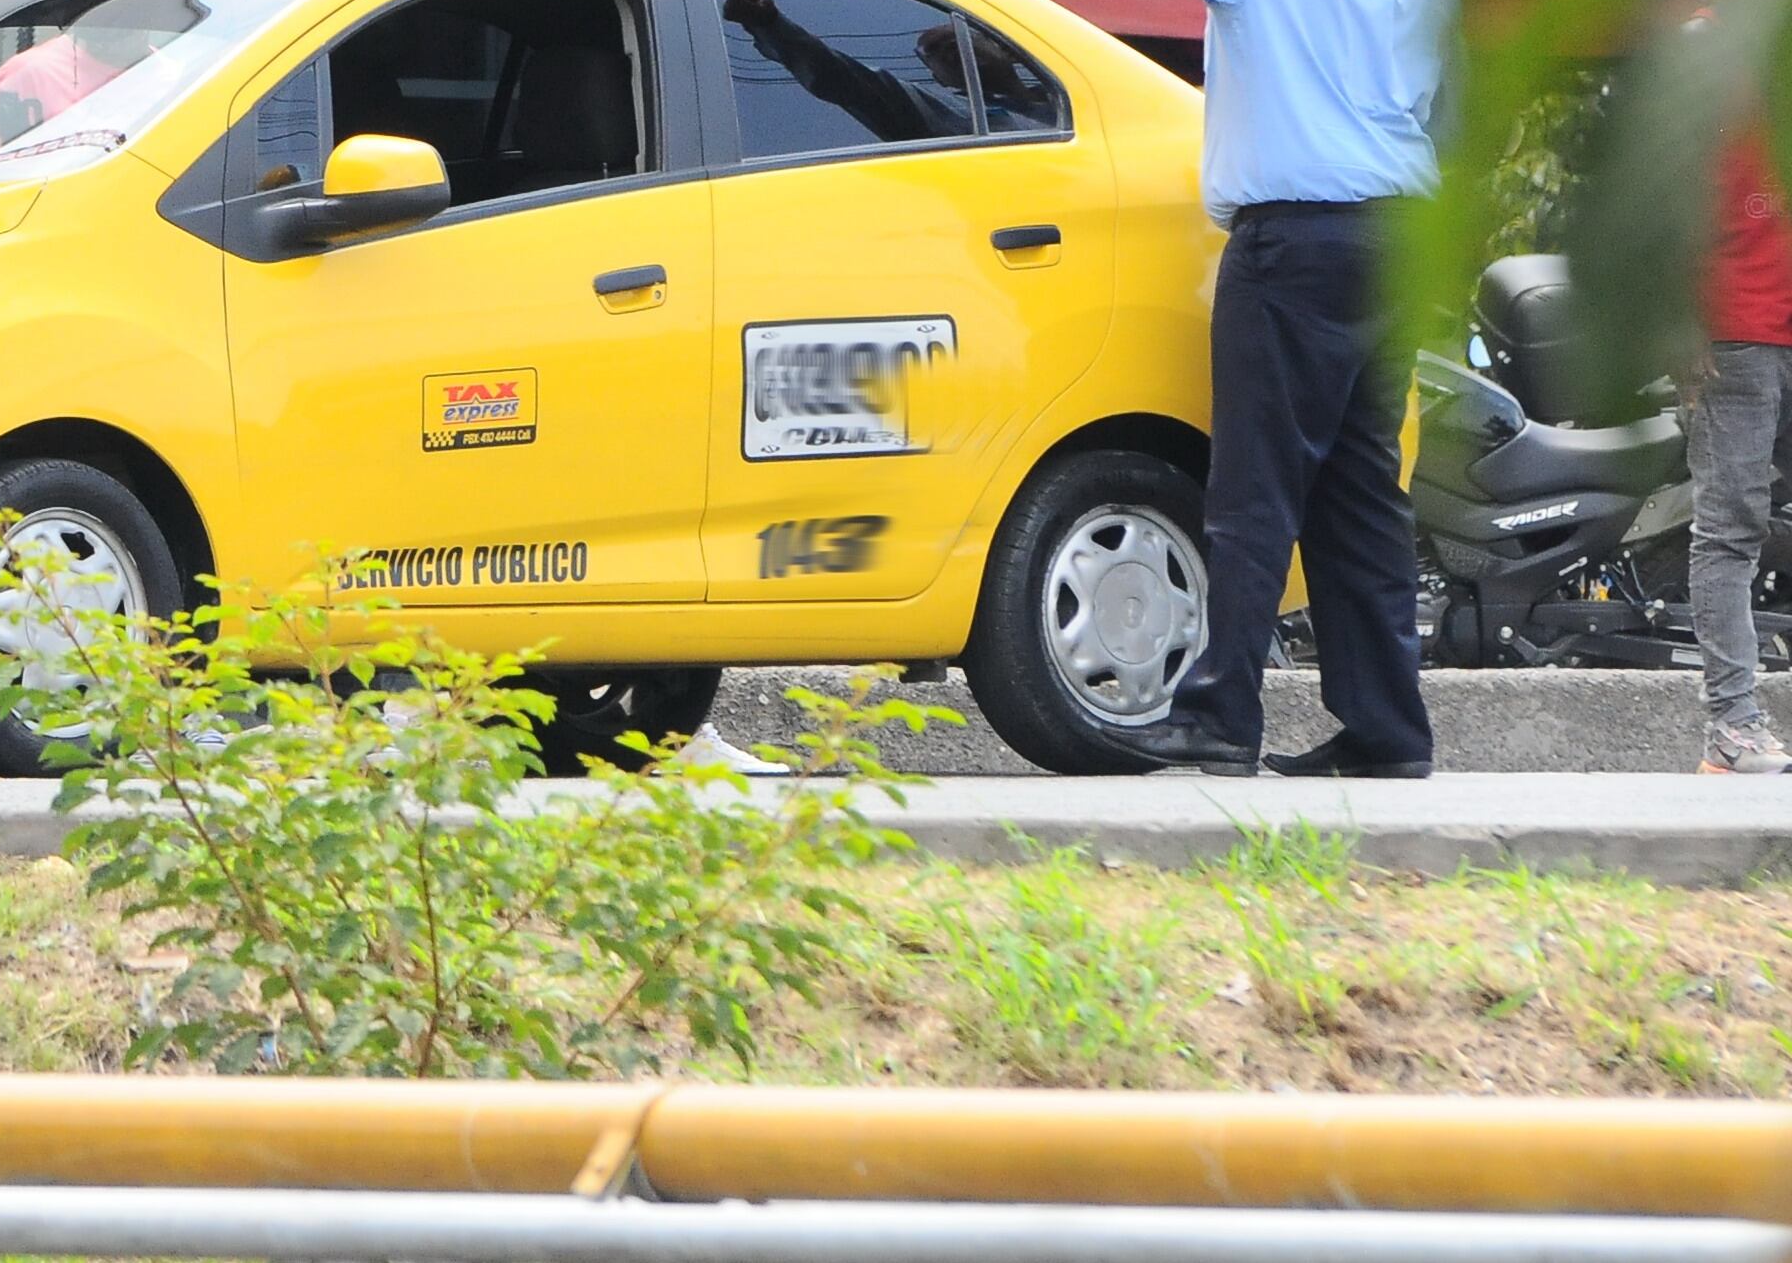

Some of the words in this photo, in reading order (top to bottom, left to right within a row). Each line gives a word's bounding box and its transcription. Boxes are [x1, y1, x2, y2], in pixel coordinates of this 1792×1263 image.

[443, 381, 519, 403] TAX
[443, 400, 519, 423] express
[1491, 500, 1579, 531] RAIDER
[472, 541, 588, 585] PUBLICO
